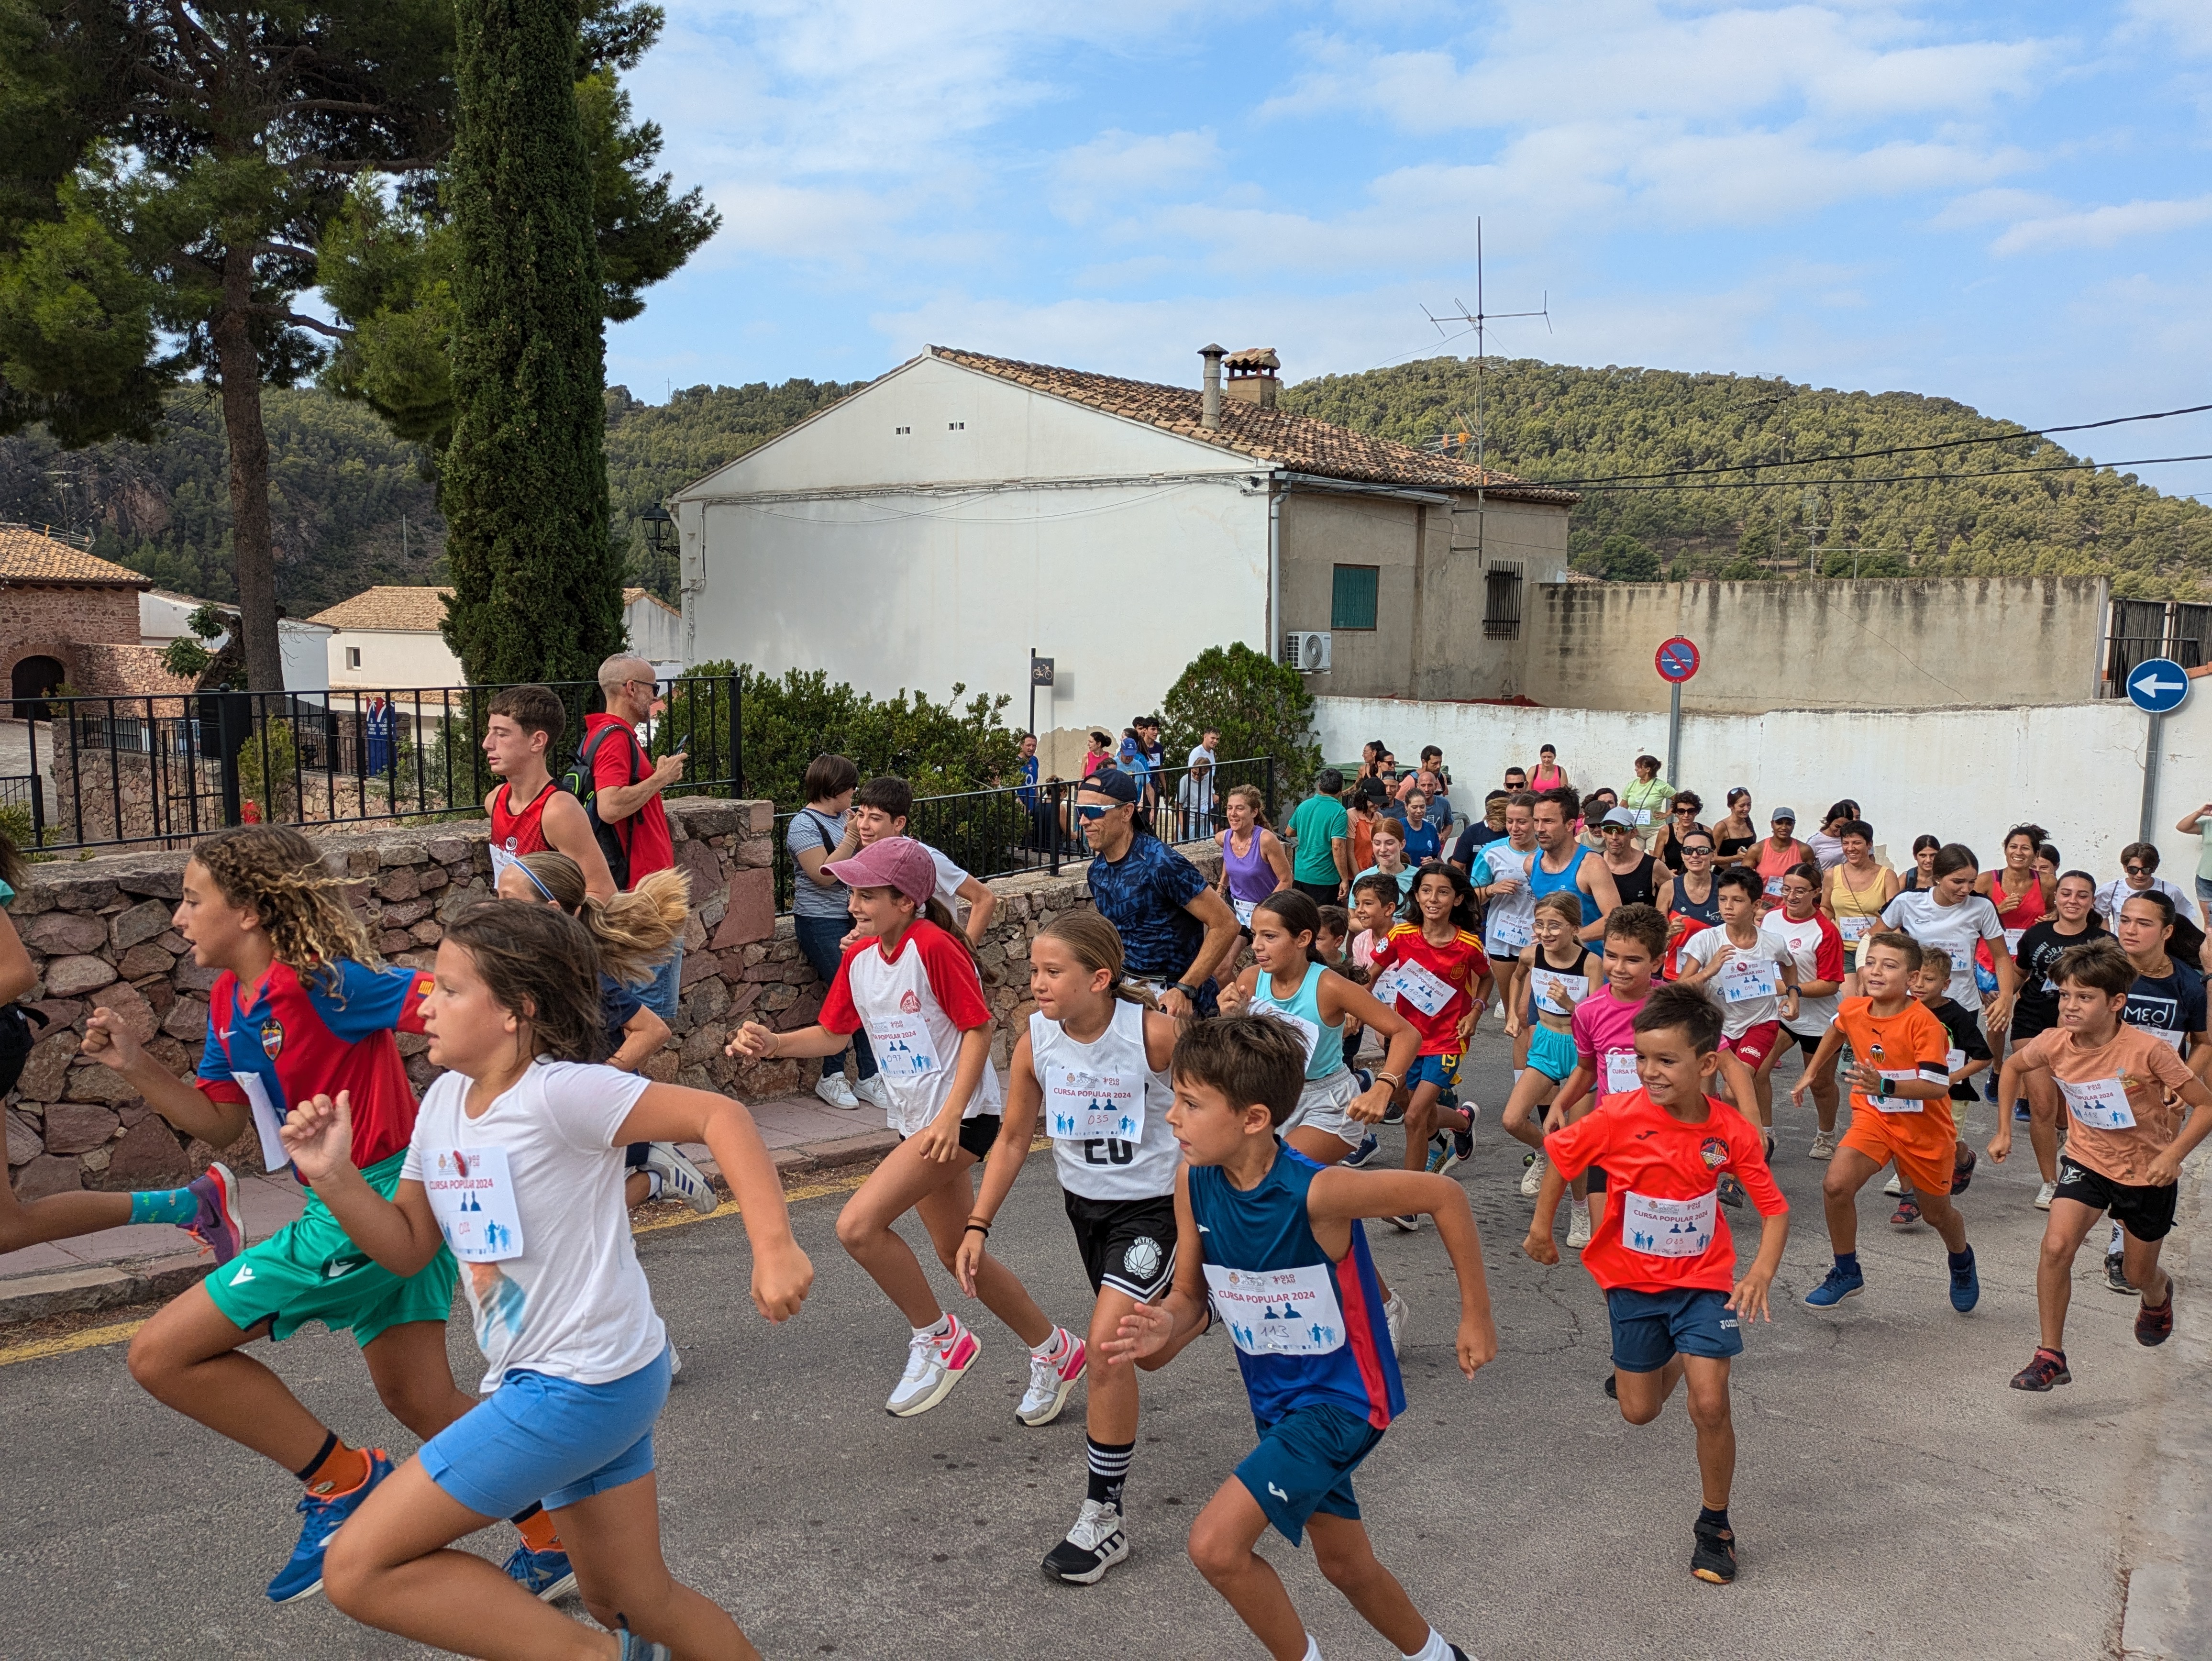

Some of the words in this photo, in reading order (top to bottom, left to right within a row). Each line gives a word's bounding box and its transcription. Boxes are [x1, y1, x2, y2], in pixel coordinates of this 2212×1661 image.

[2032, 941, 2049, 961] BASQUET
[1053, 1087, 1076, 1096] CURSA
[1088, 1115, 1109, 1125] 035
[476, 1178, 494, 1188] 2024
[1634, 1209, 1658, 1220] CURSA
[1694, 1210, 1708, 1220] 2024
[1218, 1290, 1245, 1302] CURSA
[1246, 1293, 1290, 1304] POPULAR
[1292, 1291, 1316, 1300] 2024
[1261, 1325, 1290, 1338] 113
